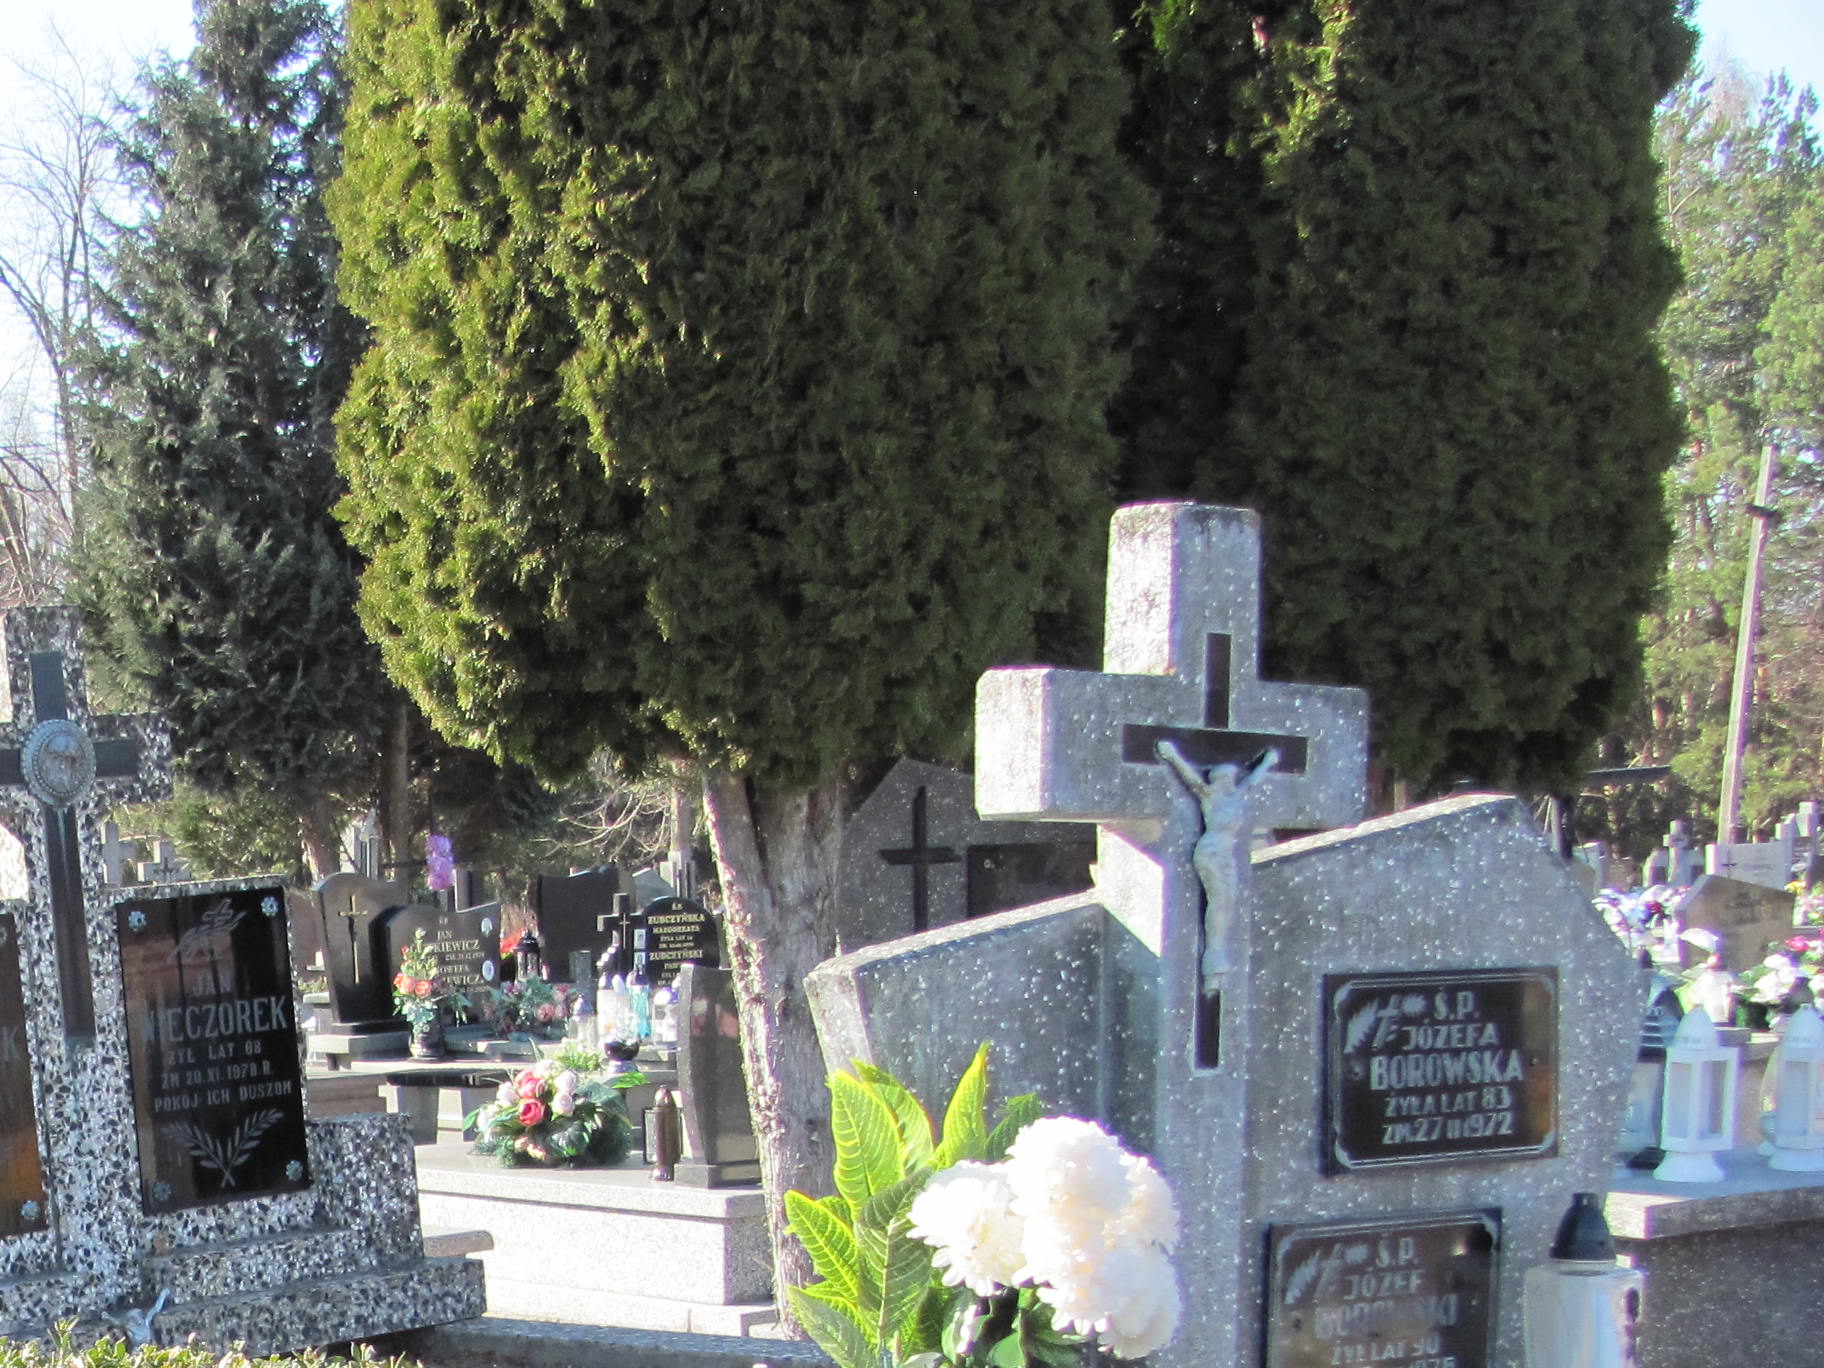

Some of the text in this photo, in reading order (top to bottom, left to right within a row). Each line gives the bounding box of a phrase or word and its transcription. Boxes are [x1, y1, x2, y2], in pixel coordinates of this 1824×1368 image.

[192, 972, 233, 997] JAN
[140, 995, 288, 1043] WIECZOREK
[1401, 1018, 1499, 1051] JÓZEFA
[208, 1042, 236, 1061] LAT
[1369, 1048, 1524, 1091] BOROWSKA
[207, 1088, 230, 1106] ICH
[239, 1080, 292, 1101] DUSZOM
[1440, 1090, 1478, 1113] LAT
[1481, 1086, 1512, 1110] 83
[1370, 1340, 1406, 1360] LAT
